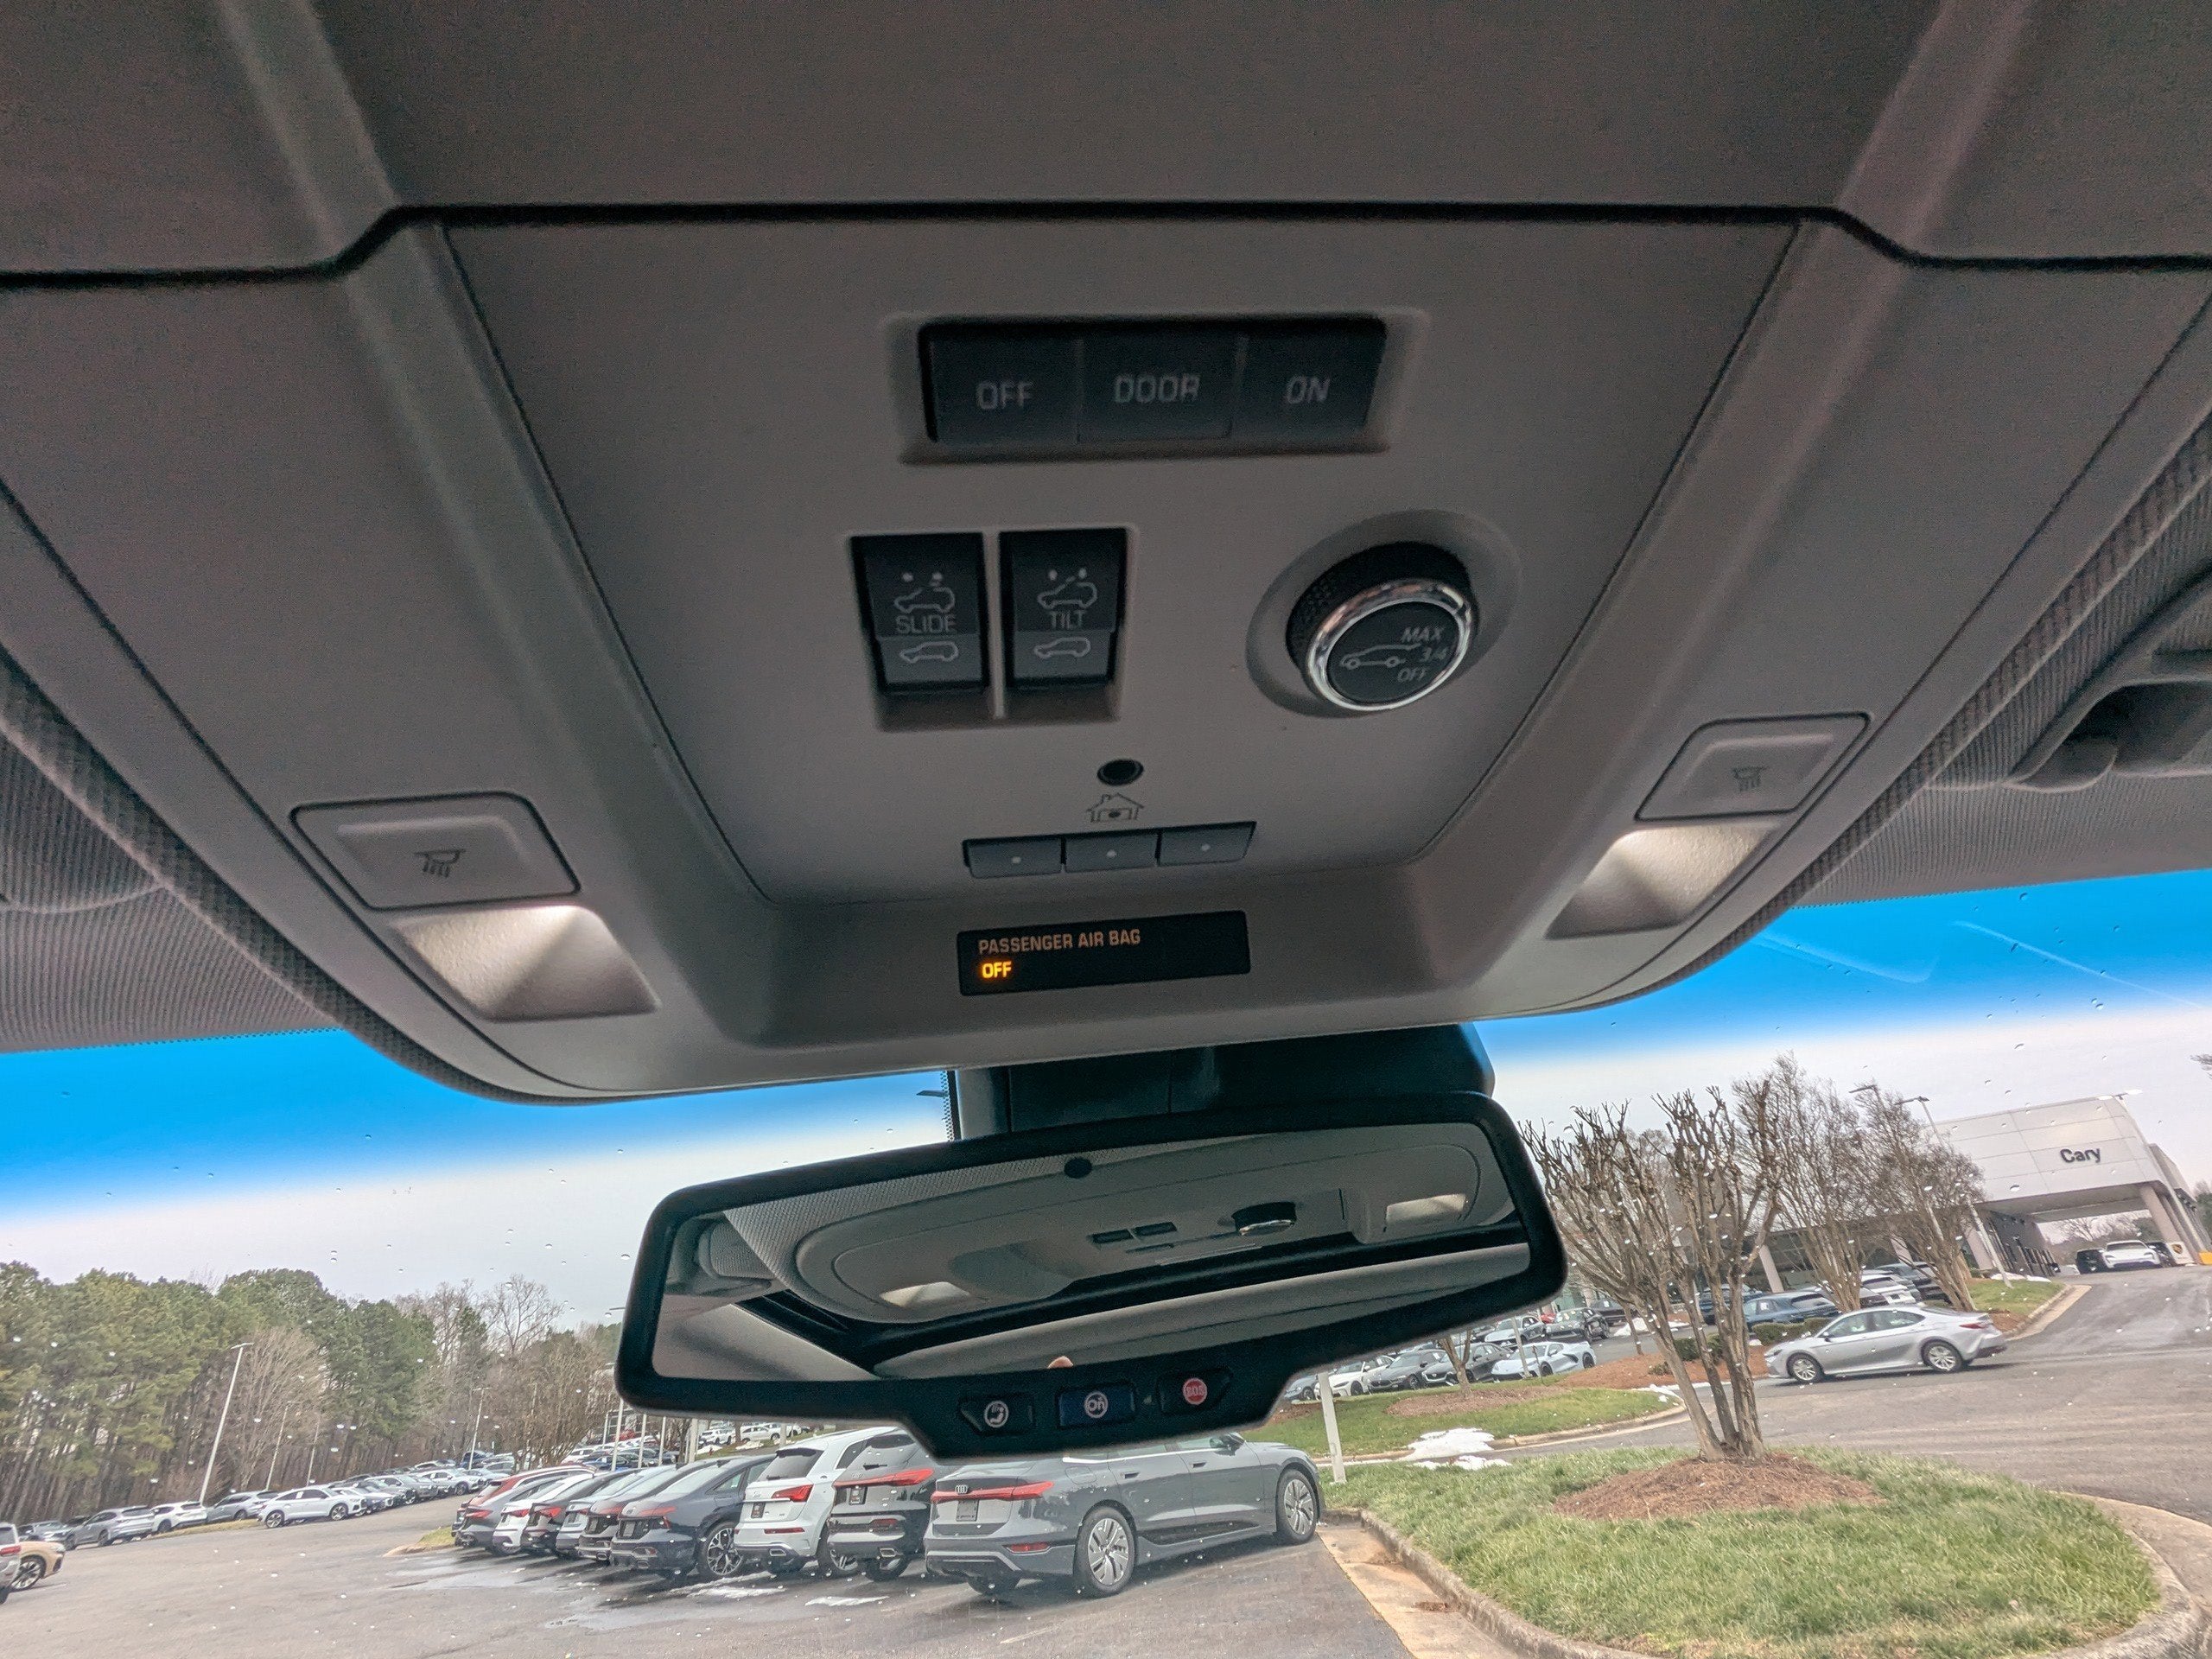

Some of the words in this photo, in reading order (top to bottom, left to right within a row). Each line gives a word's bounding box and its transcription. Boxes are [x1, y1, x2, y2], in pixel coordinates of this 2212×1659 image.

[976, 380, 1033, 410] OFF
[1113, 373, 1201, 404] DOOR
[1286, 374, 1332, 405] ON
[894, 613, 957, 634] SLIDE
[1049, 609, 1087, 631] TILT
[1400, 626, 1446, 643] MAX
[1397, 666, 1431, 683] OFF
[978, 933, 1073, 955] PASSENGER
[1078, 932, 1104, 949] AIR
[1109, 929, 1141, 946] BAG
[982, 961, 1013, 979] OFF
[2060, 1147, 2101, 1163] Cary
